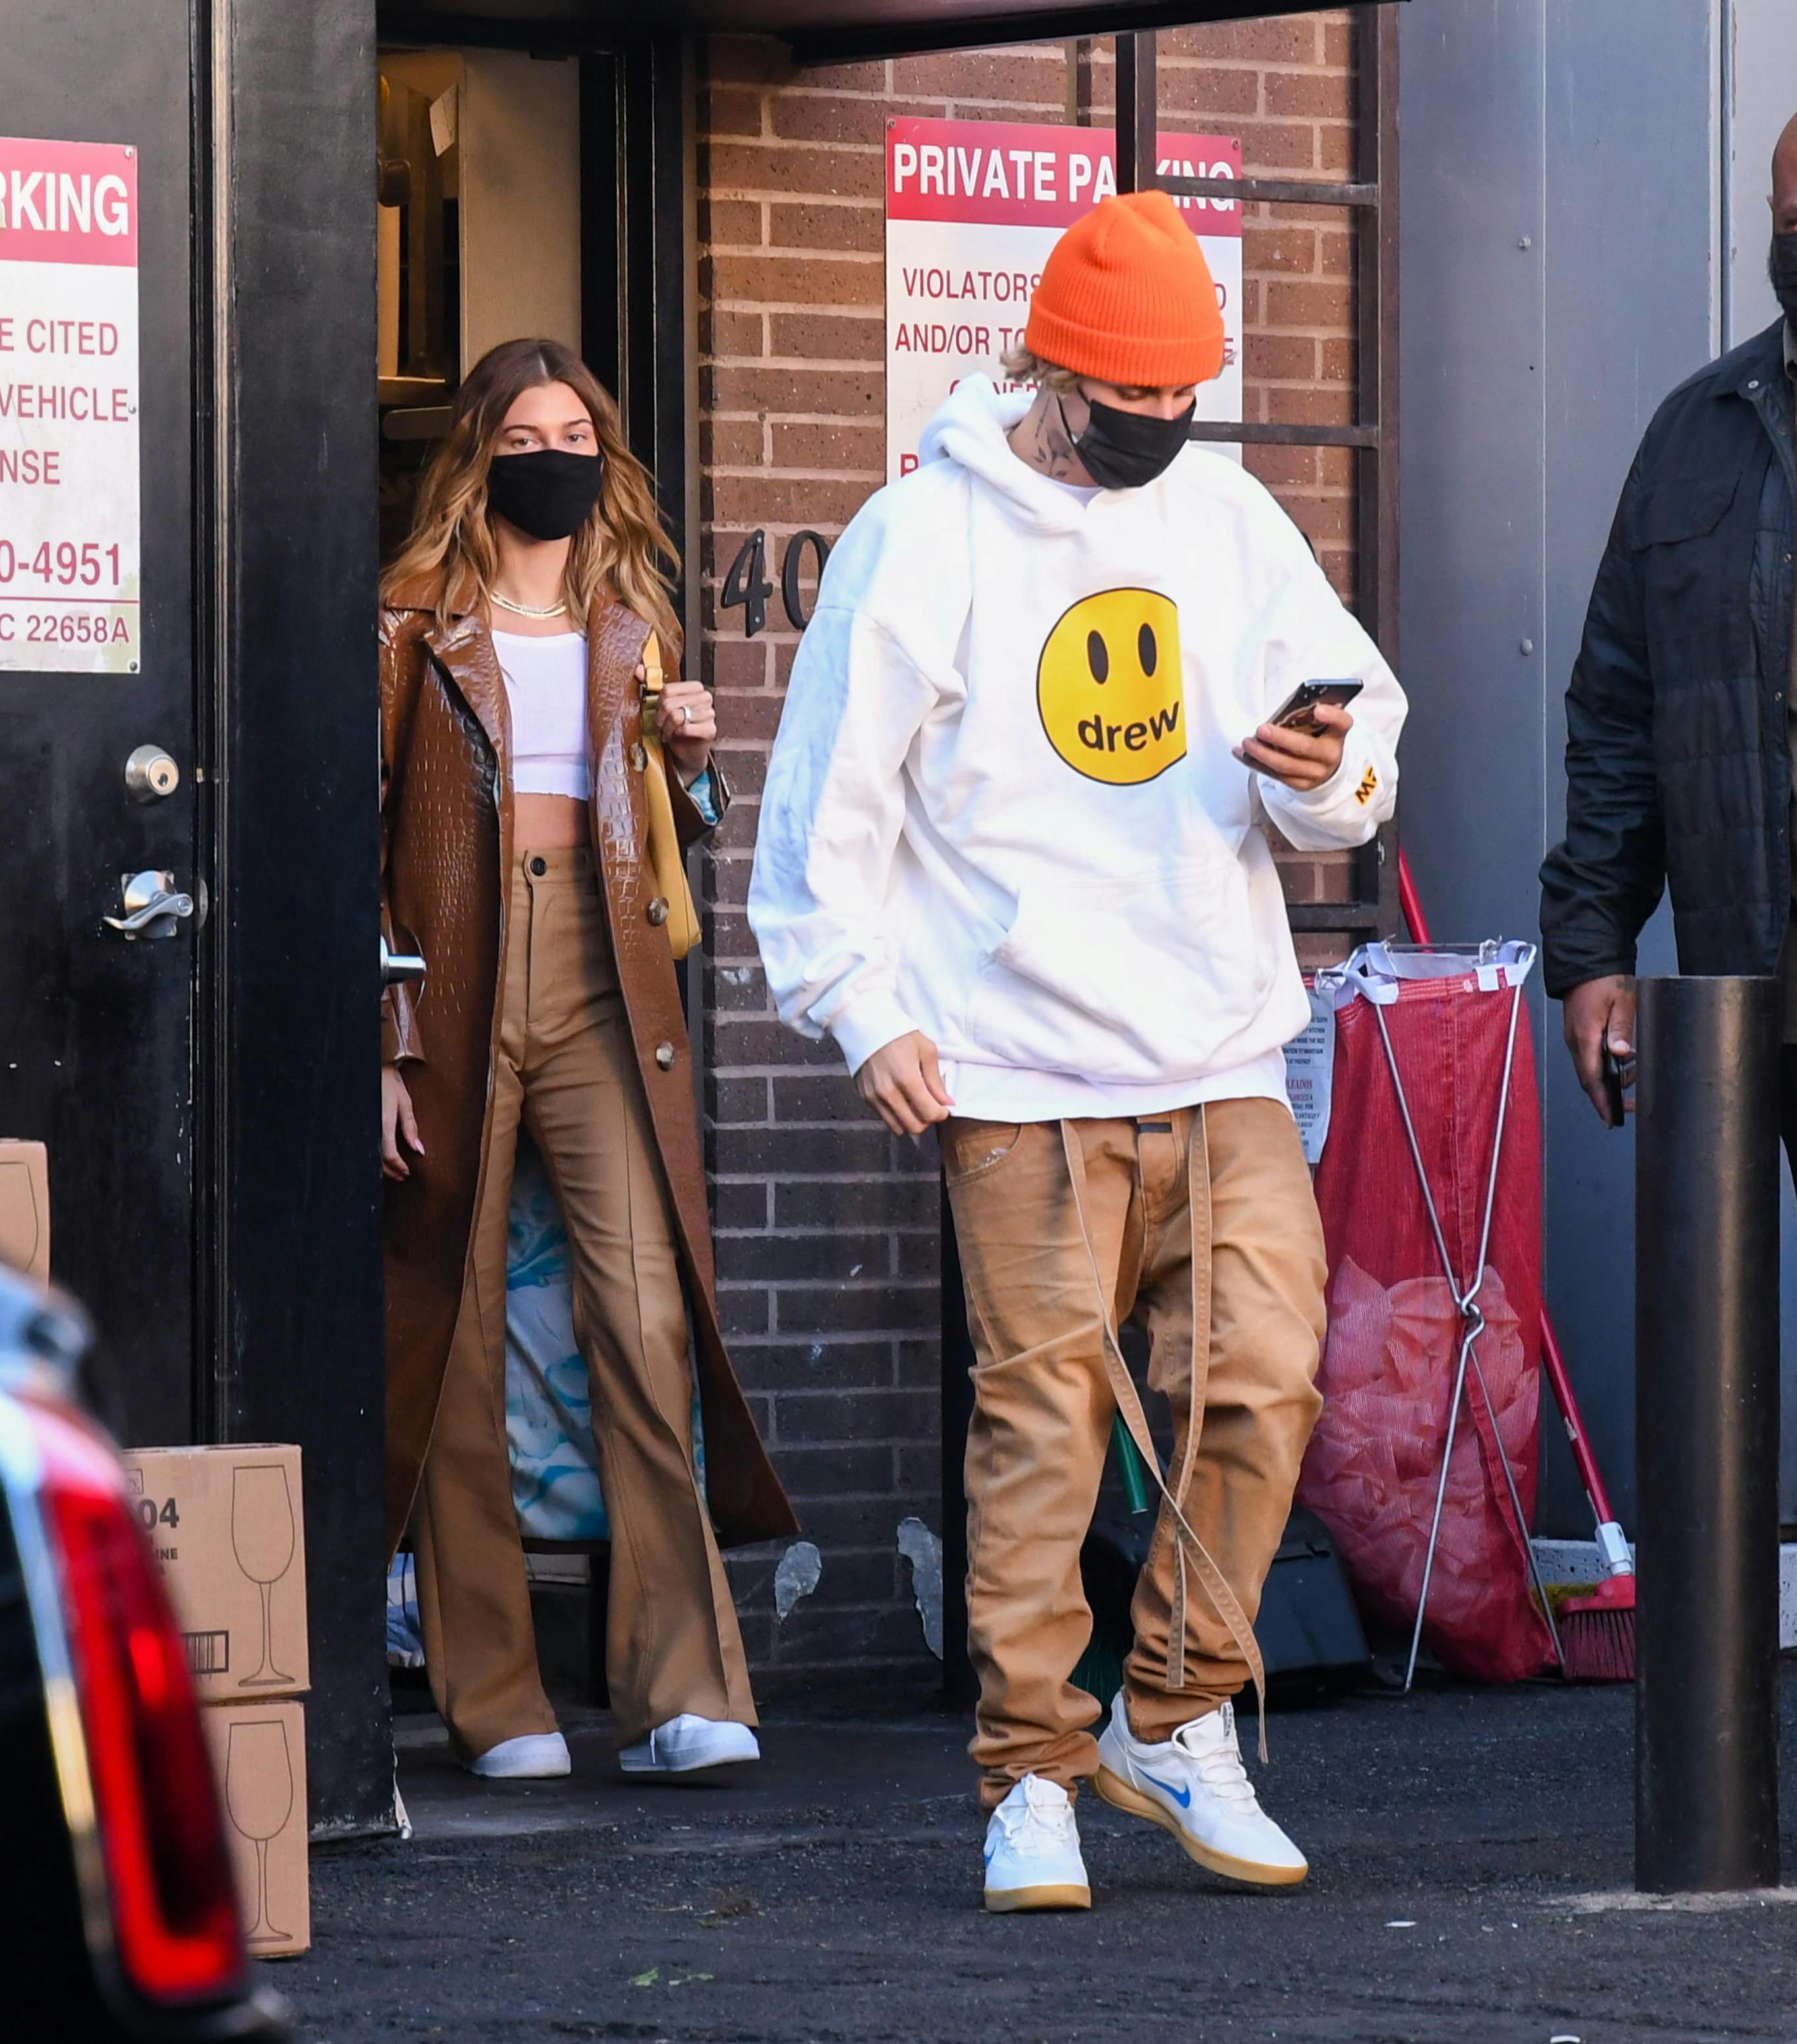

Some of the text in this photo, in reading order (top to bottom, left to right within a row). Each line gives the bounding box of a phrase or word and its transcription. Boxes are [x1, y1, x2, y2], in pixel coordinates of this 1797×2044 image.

[894, 143, 1234, 212] PRIVATE PAING
[0, 170, 129, 236] KING
[27, 319, 118, 355] CITED
[895, 323, 990, 355] AND/OR
[0, 384, 128, 422] VEHICLE
[0, 450, 60, 485] NSE
[721, 529, 830, 638] 40
[27, 615, 129, 644] 22658A
[1078, 701, 1179, 752] drew
